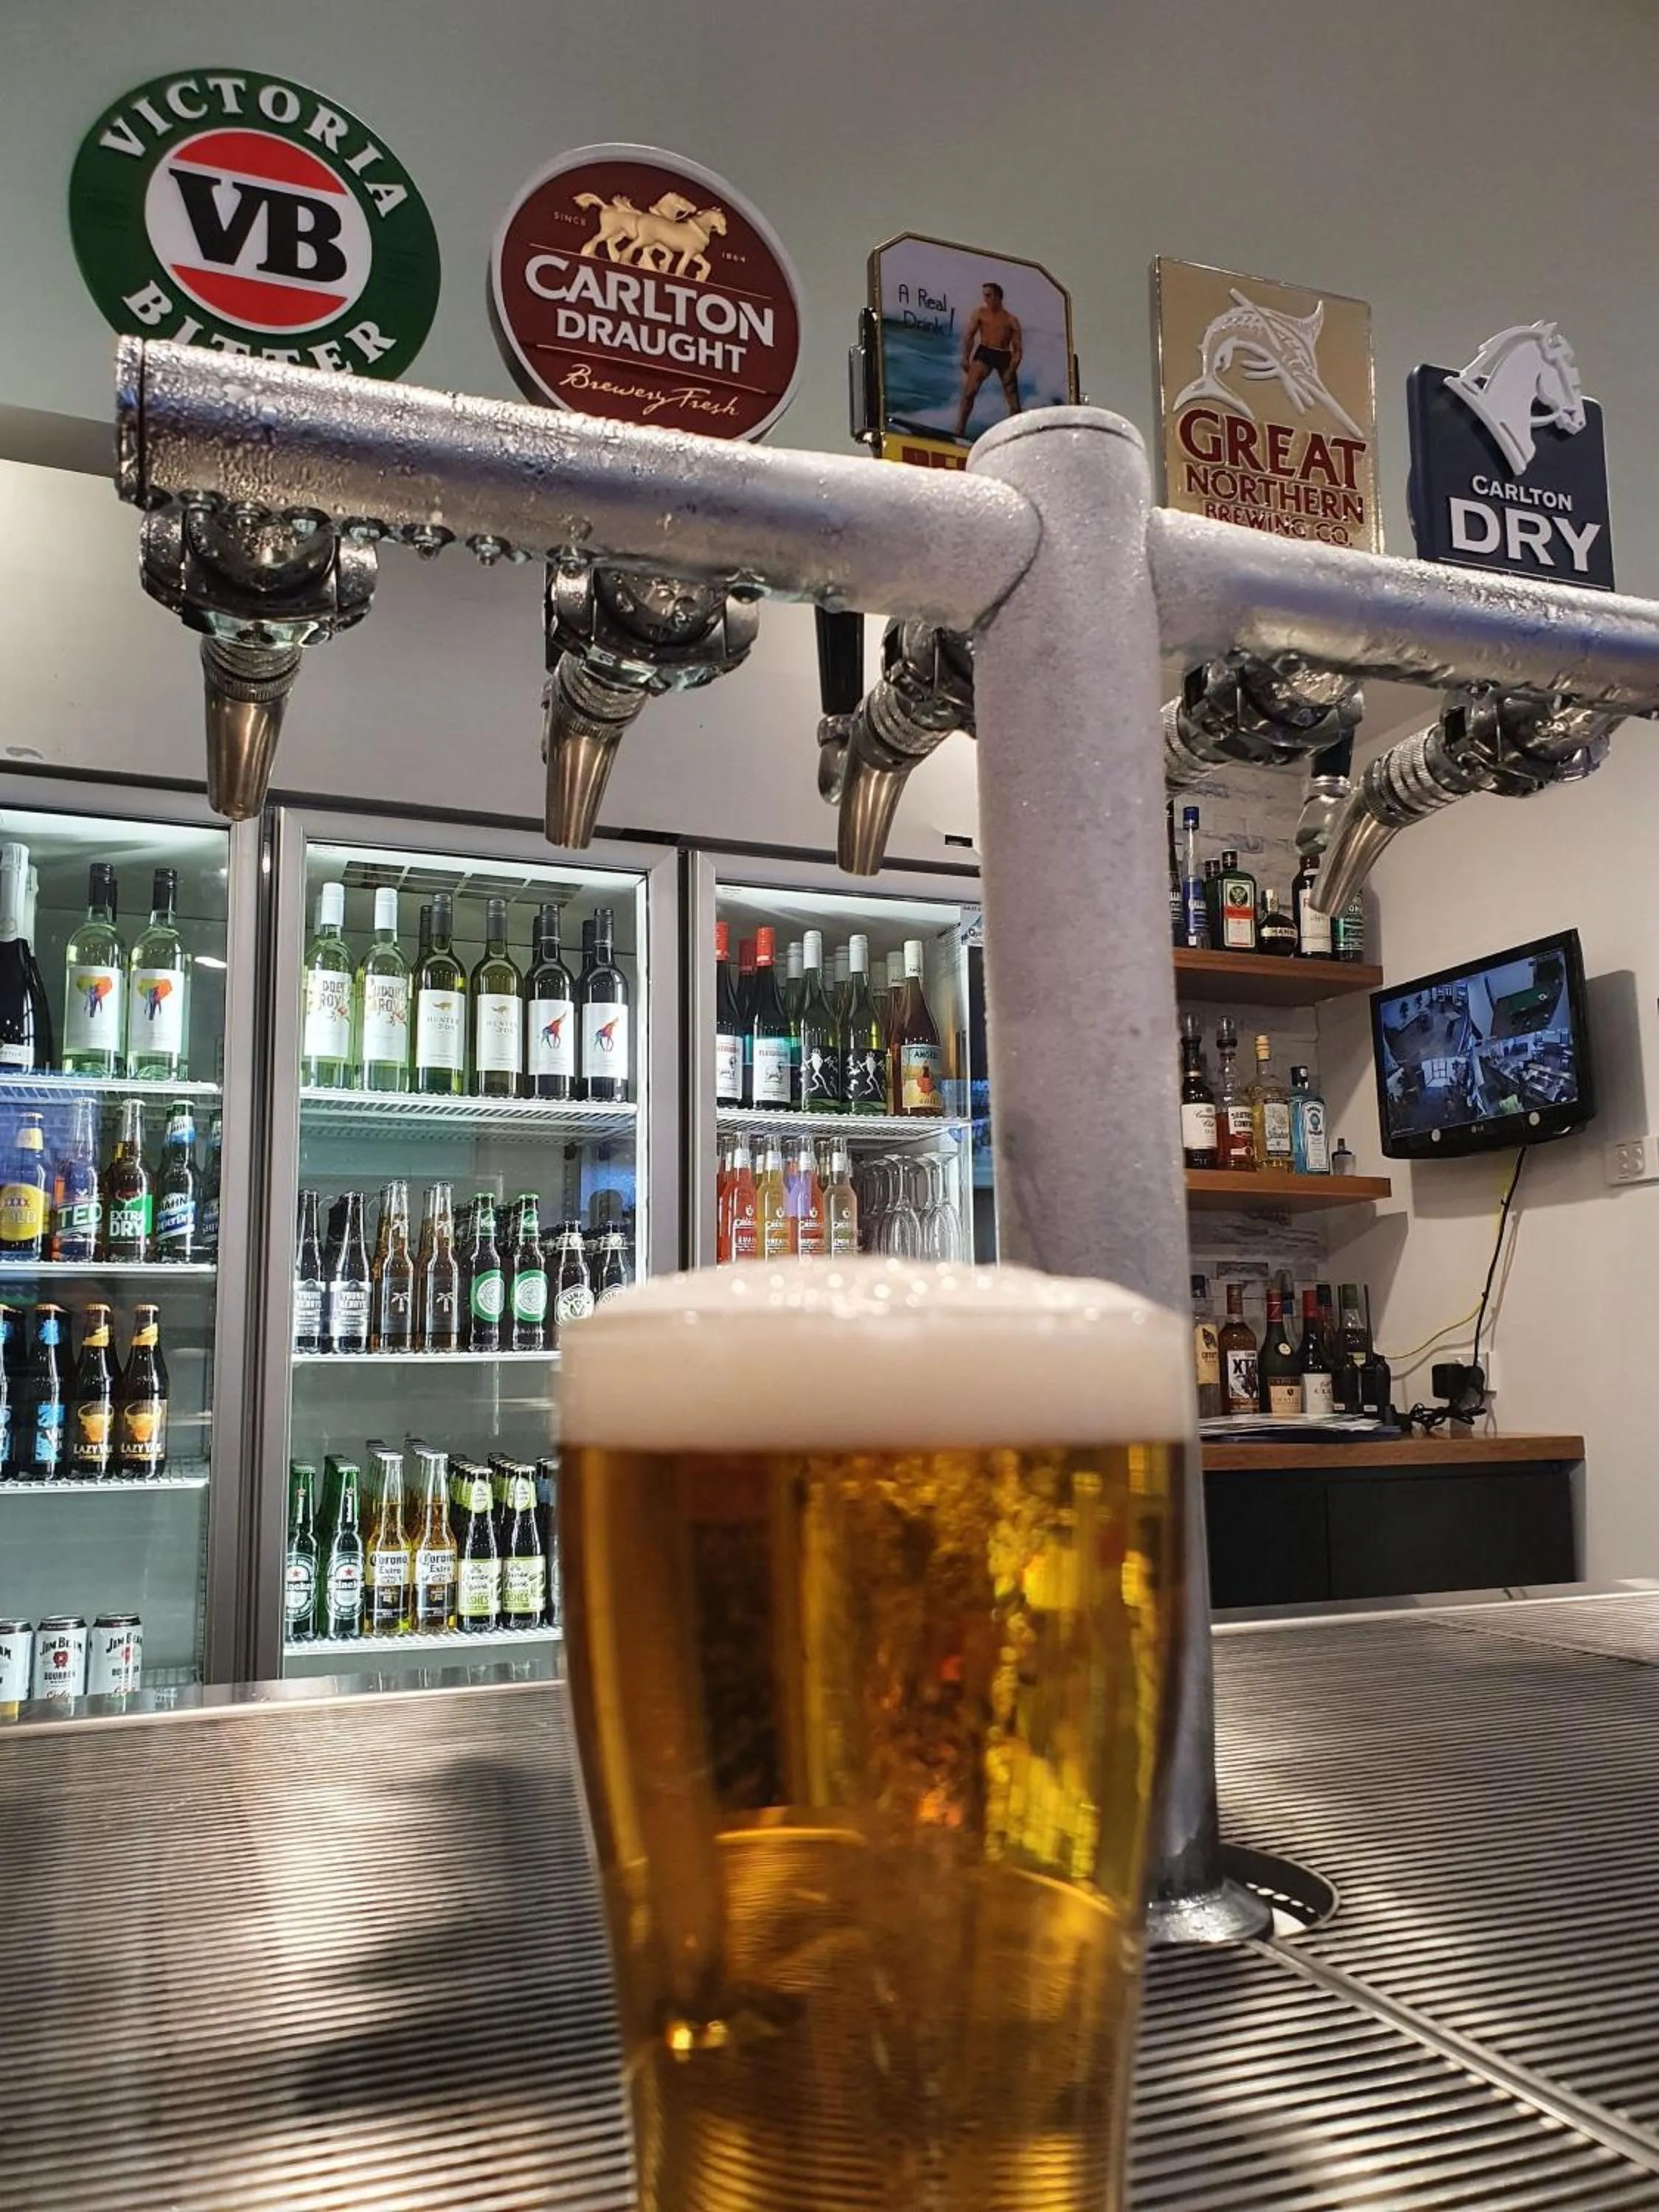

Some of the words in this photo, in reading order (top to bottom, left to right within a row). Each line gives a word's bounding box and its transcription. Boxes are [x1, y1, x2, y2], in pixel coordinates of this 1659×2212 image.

[100, 77, 409, 218] VICTORIA
[168, 167, 348, 283] VB
[554, 211, 587, 226] SINCE
[524, 254, 775, 347] CARLTON
[898, 284, 909, 305] A
[918, 288, 947, 313] Real
[556, 308, 747, 373] DRAUGHT
[559, 363, 671, 416] Brewery
[669, 386, 740, 416] Fresh
[1179, 408, 1367, 490] GREAT
[1186, 464, 1364, 525] NORTHERN
[1472, 474, 1573, 512] CARLTON
[1204, 500, 1307, 538] BREWING
[1449, 495, 1601, 572] DRY
[109, 1220, 144, 1237] DRY
[74, 1443, 99, 1455] LAZY
[121, 1443, 144, 1454] LAZY
[58, 1636, 83, 1655] BEM
